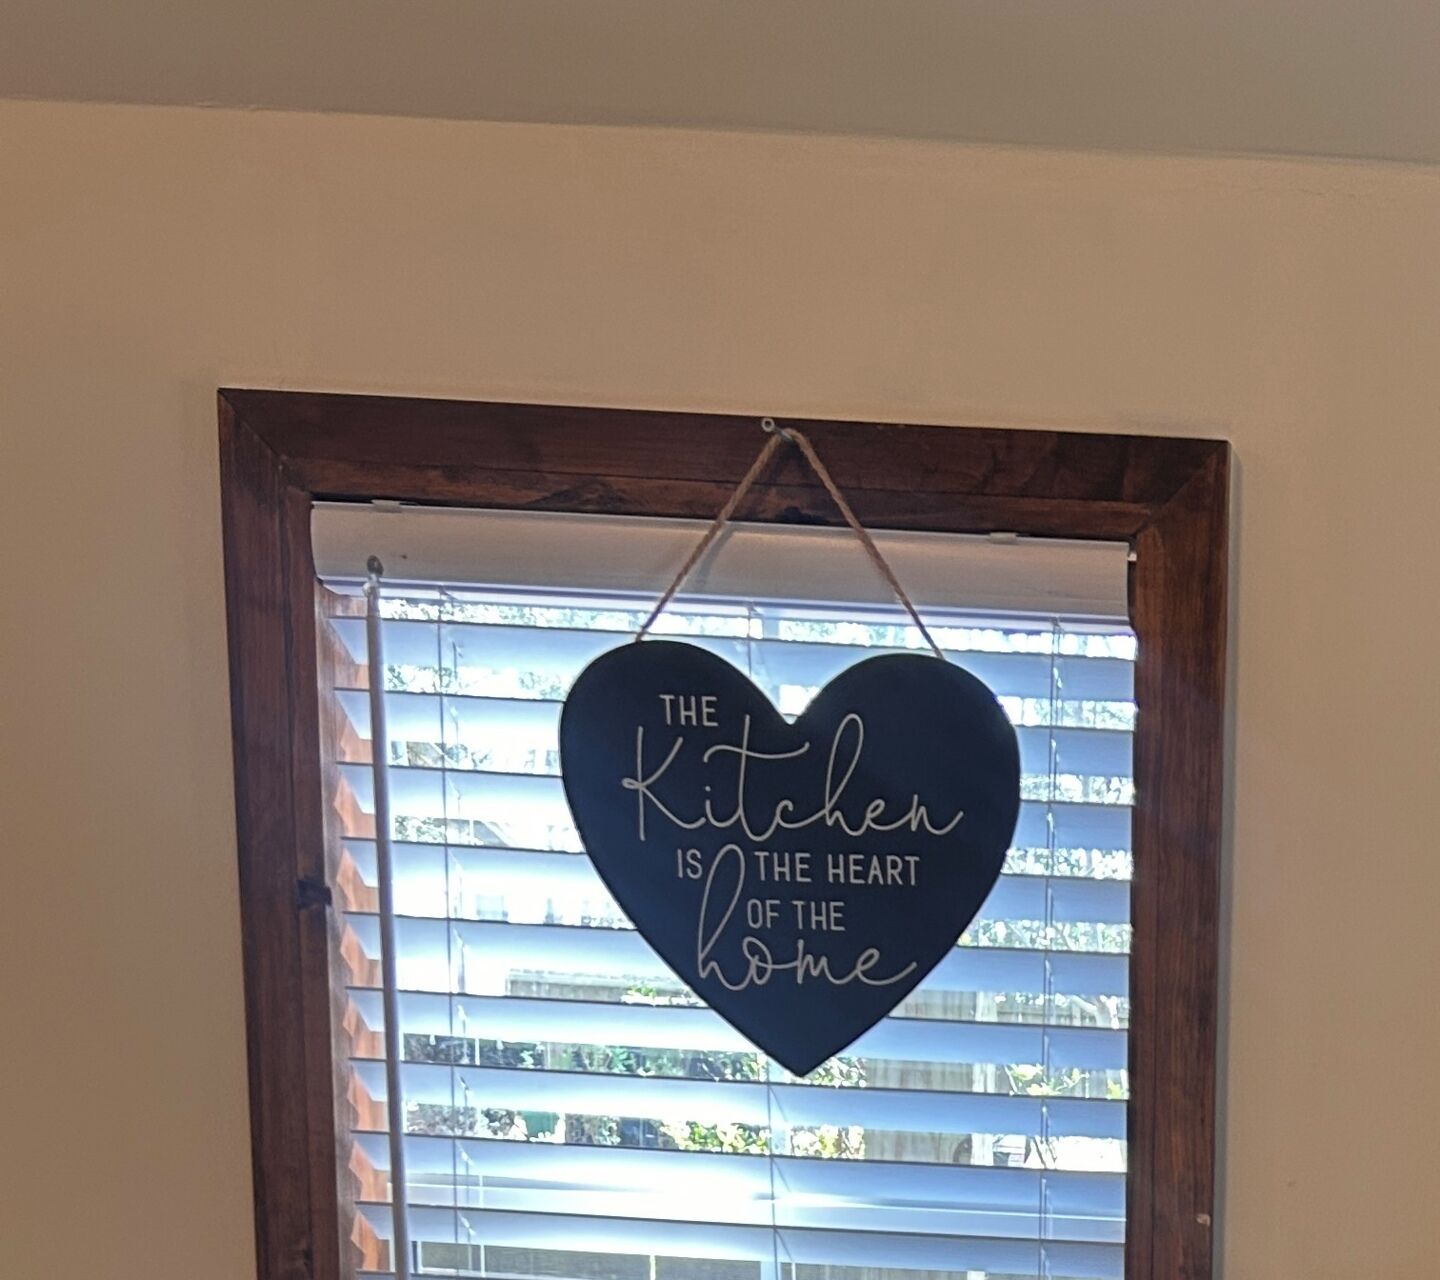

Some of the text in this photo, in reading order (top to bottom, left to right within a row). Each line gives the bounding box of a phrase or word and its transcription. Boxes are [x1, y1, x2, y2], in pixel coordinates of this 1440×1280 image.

[659, 694, 719, 727] THE
[622, 713, 964, 841] Kitchen
[677, 849, 920, 886] IS THE HEART
[698, 844, 917, 990] home
[747, 898, 846, 931] OF THE
